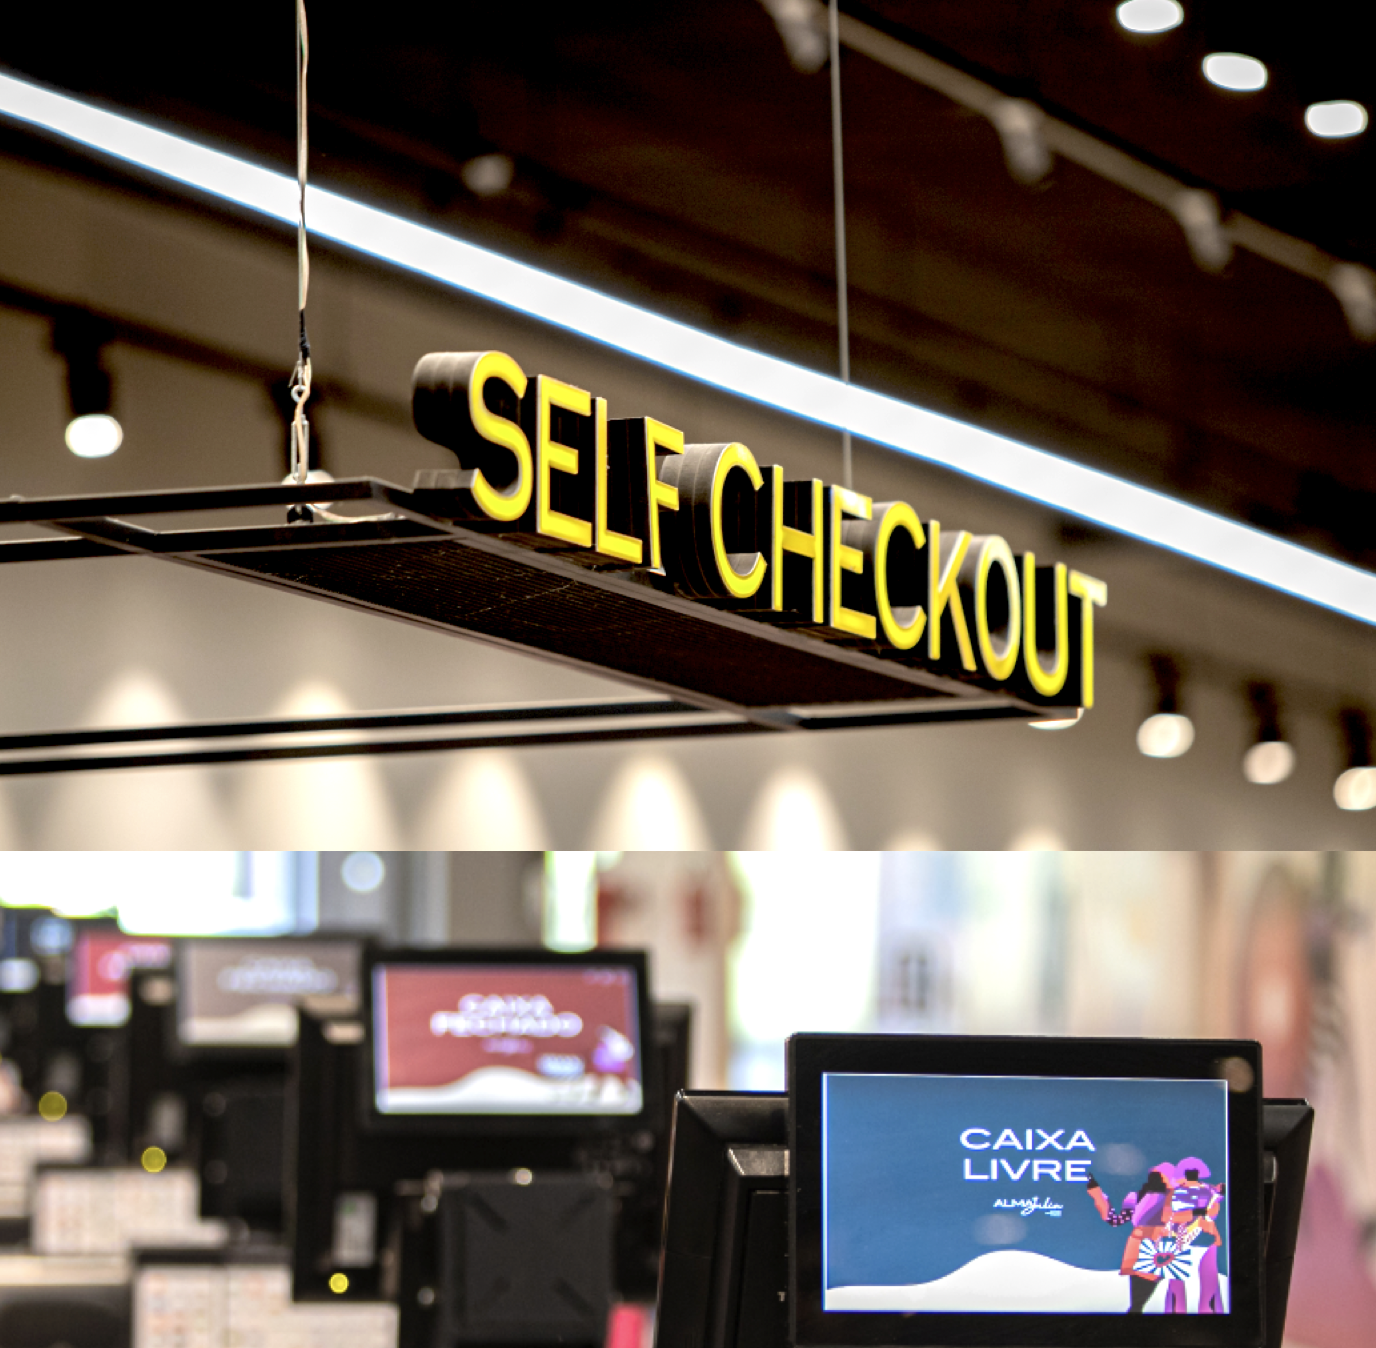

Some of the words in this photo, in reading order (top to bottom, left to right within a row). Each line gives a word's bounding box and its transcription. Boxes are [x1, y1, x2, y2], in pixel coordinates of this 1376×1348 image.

[470, 351, 685, 570] SELF
[711, 442, 1108, 709] CHECKOUT
[959, 1127, 1096, 1152] CAIXA
[963, 1158, 1092, 1182] LIVRE
